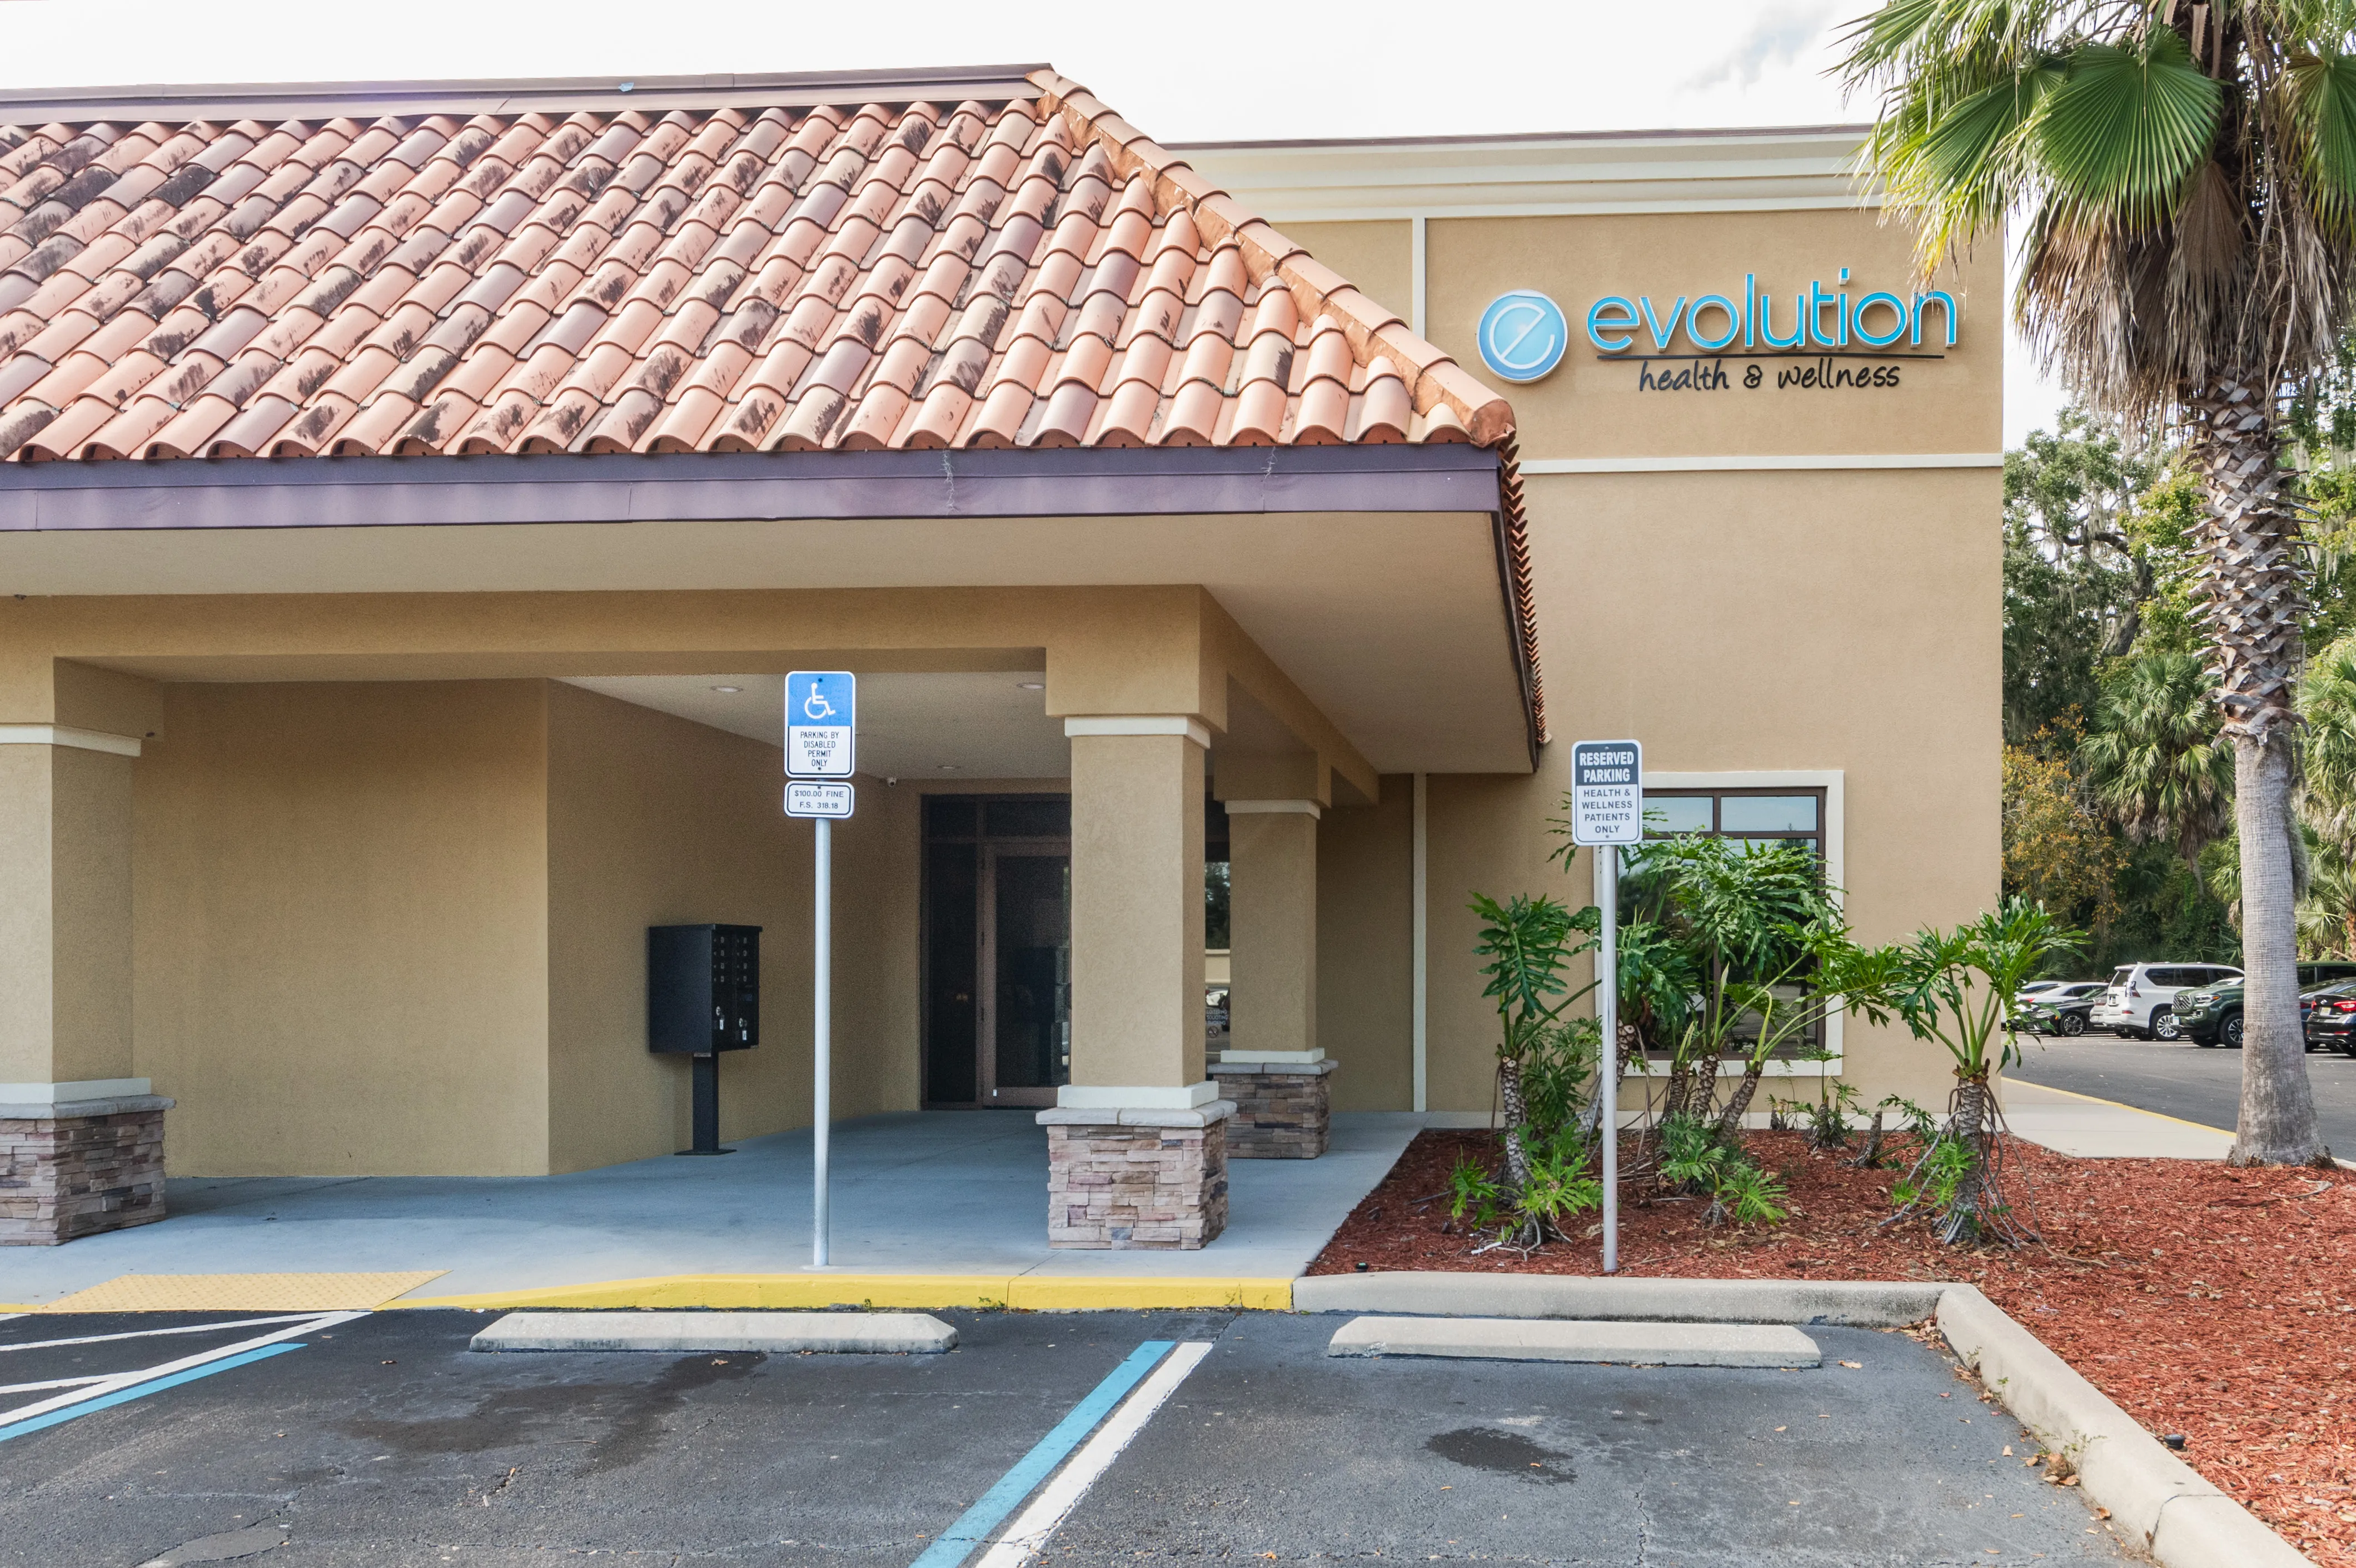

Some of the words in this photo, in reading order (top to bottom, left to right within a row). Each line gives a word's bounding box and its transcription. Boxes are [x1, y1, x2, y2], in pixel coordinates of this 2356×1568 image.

[1587, 267, 1957, 353] evolution
[1639, 358, 1729, 391] health
[1742, 364, 1762, 389] &
[1778, 357, 1900, 389] wellness
[1580, 751, 1634, 766] RESERVED
[1584, 768, 1630, 782] PARKING
[1584, 789, 1621, 797] HEALTH
[1582, 801, 1632, 809] WELLNESS
[1585, 813, 1630, 821] PATIENTS
